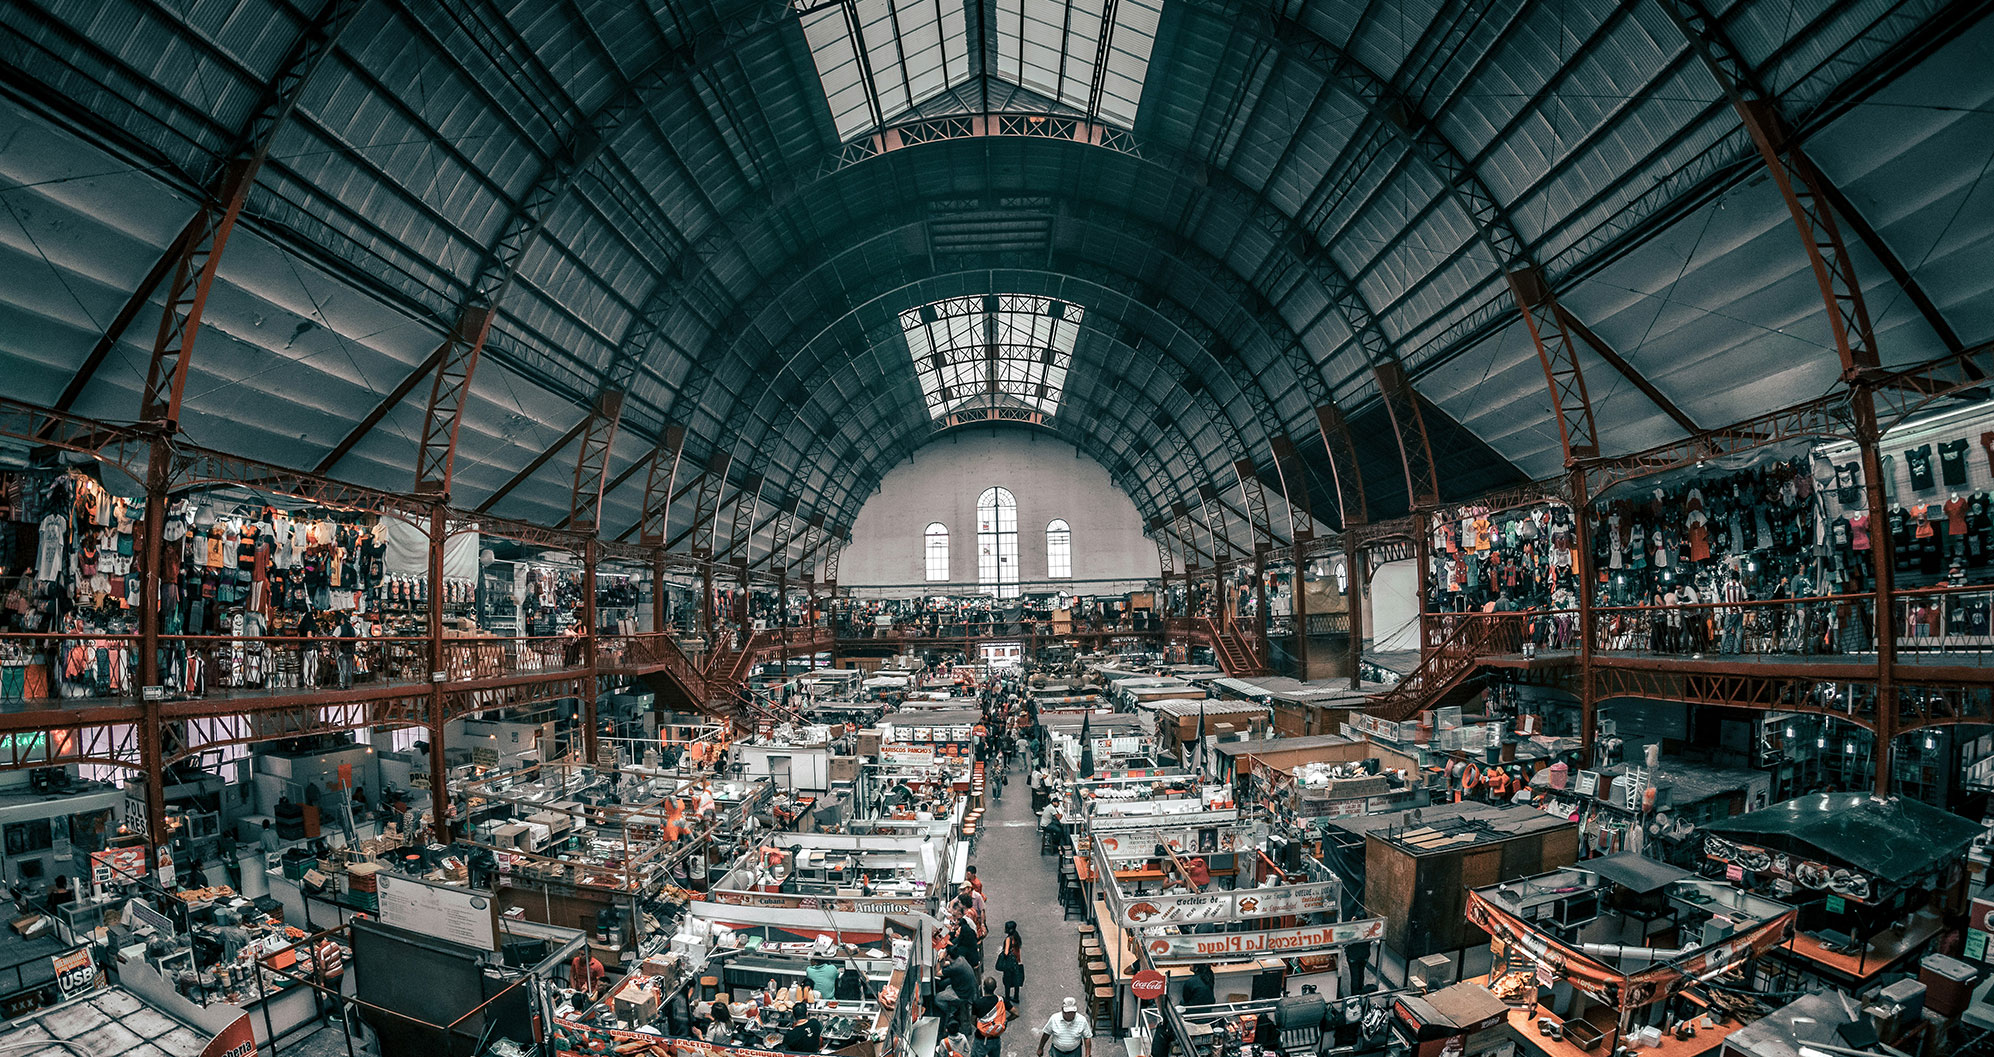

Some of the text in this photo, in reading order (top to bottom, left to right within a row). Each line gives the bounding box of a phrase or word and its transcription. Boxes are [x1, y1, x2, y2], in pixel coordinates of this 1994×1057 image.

[409, 773, 432, 783] POLL
[125, 799, 147, 820] POLL
[125, 814, 148, 834] FRES
[719, 894, 750, 903] TOAS
[856, 902, 909, 914] Antojitos
